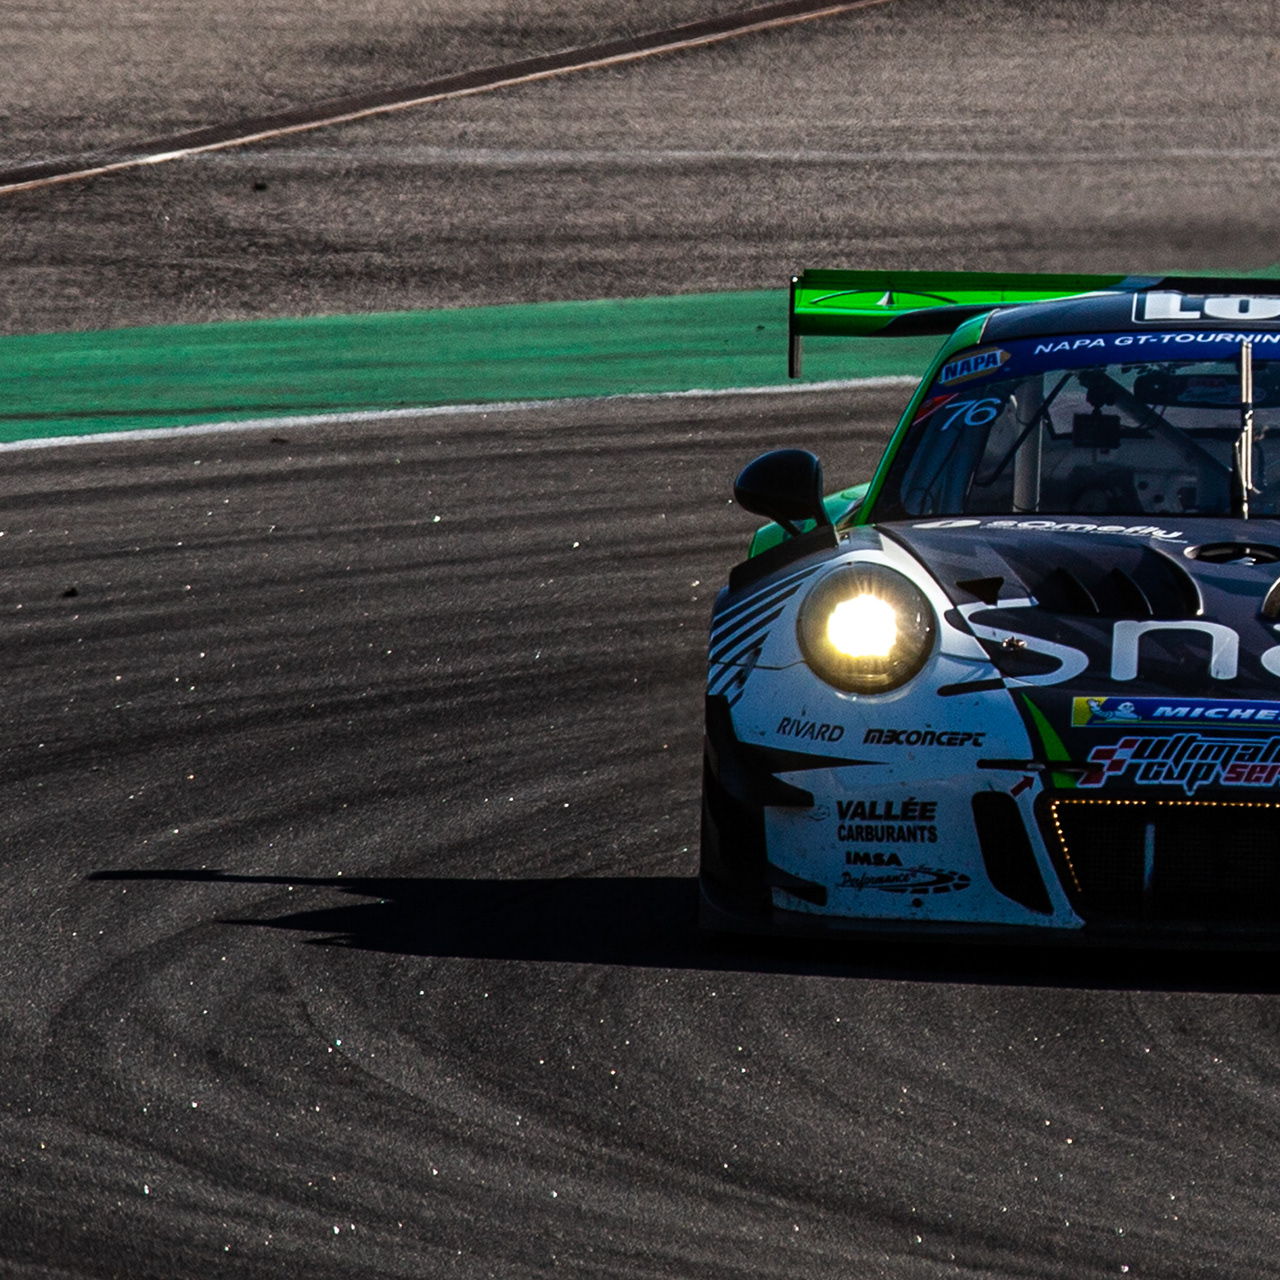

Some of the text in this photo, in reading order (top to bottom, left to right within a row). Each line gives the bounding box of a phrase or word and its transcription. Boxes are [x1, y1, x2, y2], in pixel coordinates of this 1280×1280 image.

[1034, 337, 1106, 355] NAPA
[943, 351, 998, 380] NAPA
[941, 398, 1001, 432] 76
[776, 717, 845, 742] RIVARD
[836, 796, 938, 821] VALLÉE
[837, 824, 938, 843] CARBURANTS
[845, 851, 902, 866] IMSA
[840, 871, 912, 891] Performance
